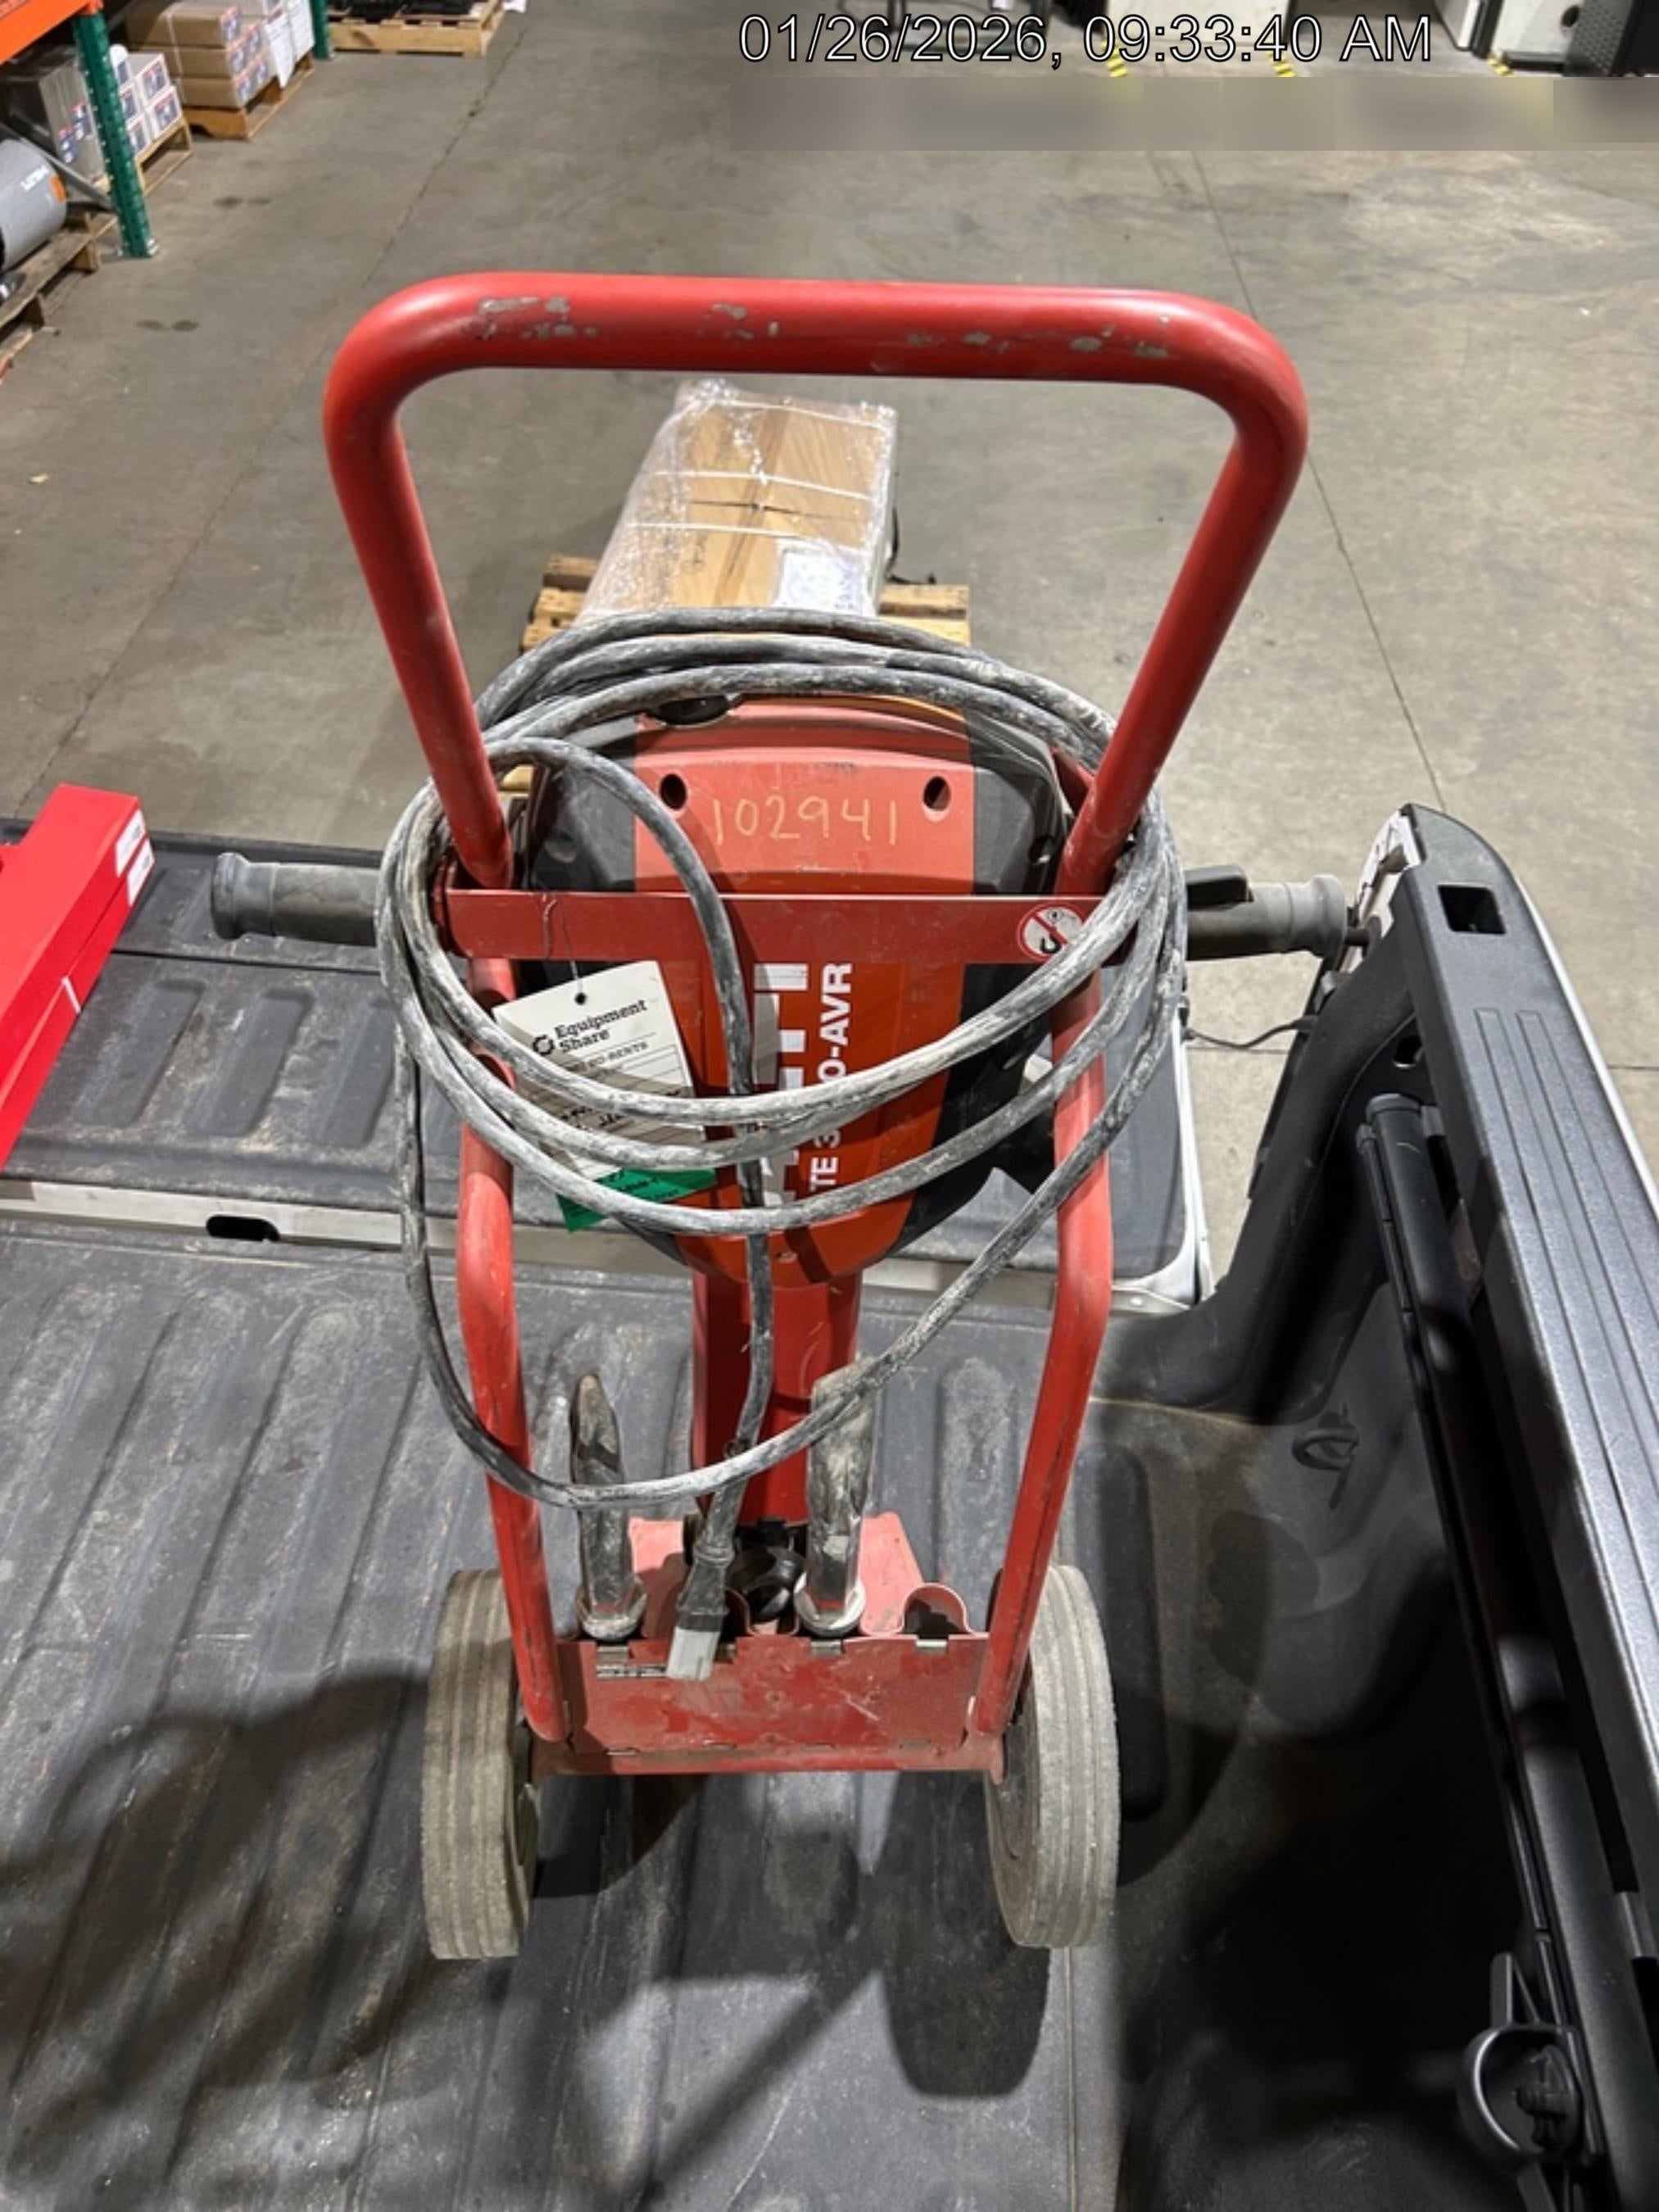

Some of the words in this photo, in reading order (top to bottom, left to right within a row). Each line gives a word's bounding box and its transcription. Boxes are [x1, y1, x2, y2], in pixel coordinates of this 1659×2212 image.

[712, 794, 897, 846] 102941
[554, 999, 647, 1040] Equipment
[560, 1029, 610, 1054] Share
[812, 962, 854, 1149] 30-AVR
[809, 1156, 840, 1192] TE
